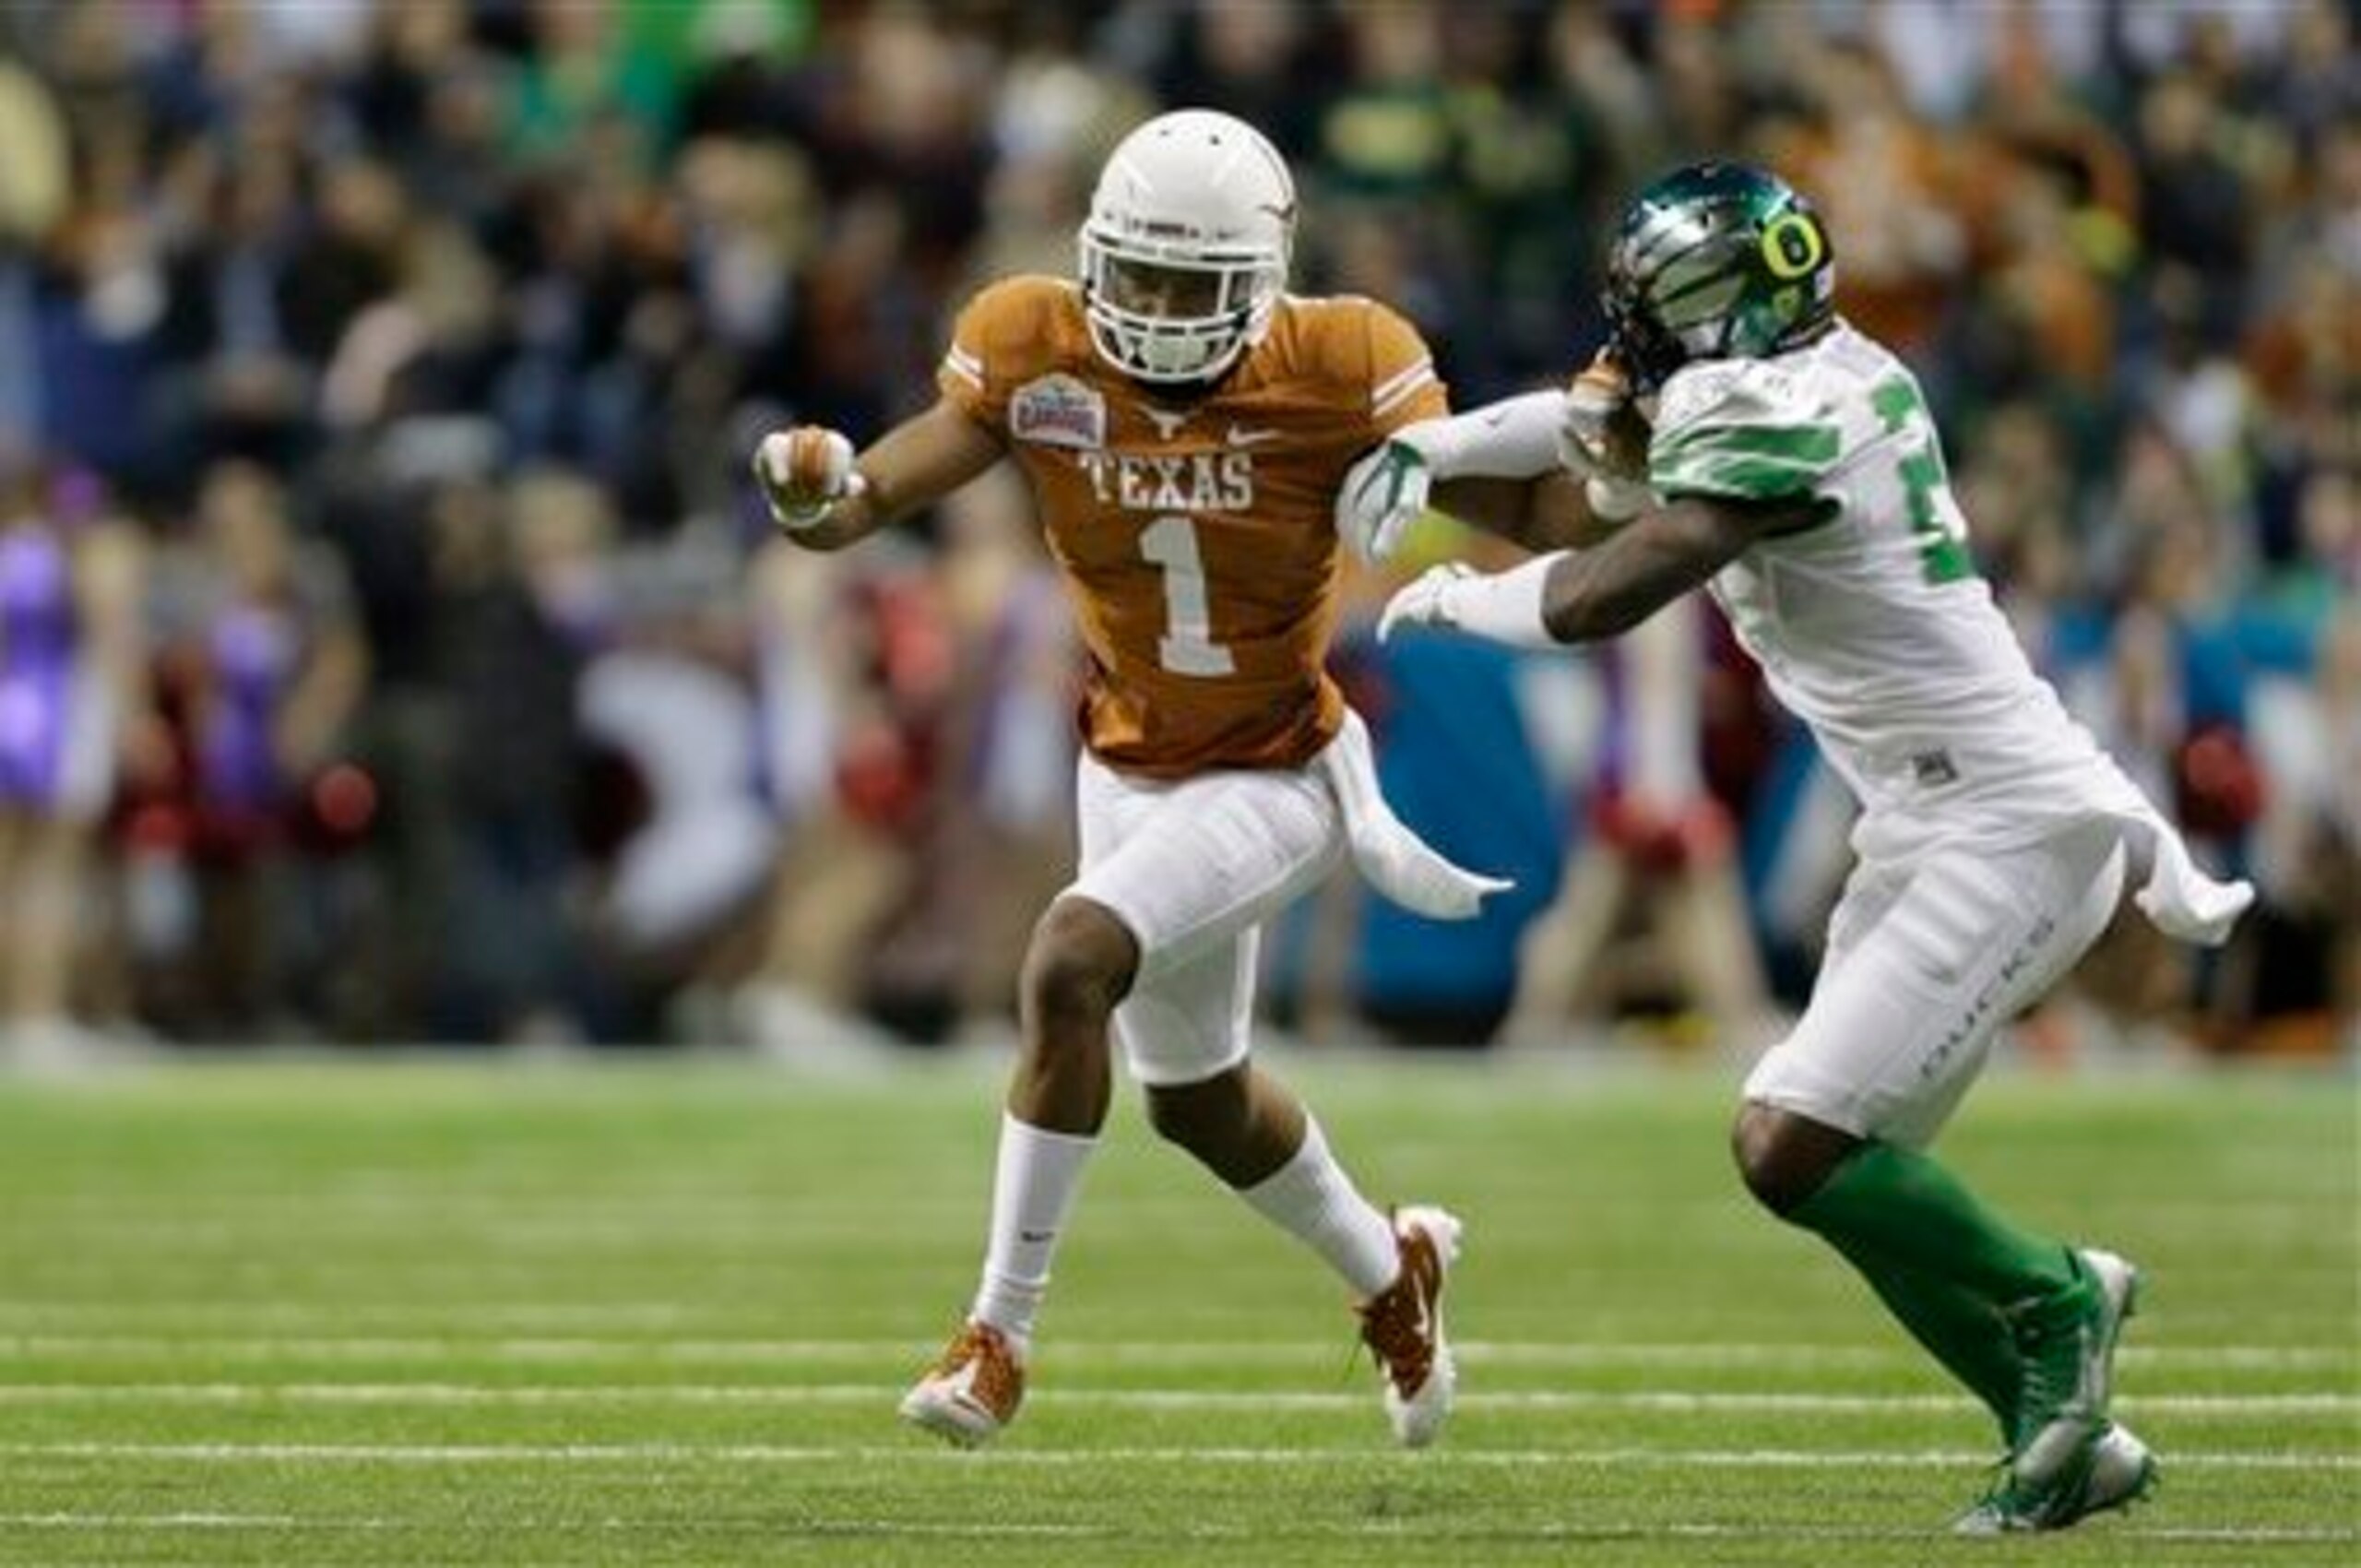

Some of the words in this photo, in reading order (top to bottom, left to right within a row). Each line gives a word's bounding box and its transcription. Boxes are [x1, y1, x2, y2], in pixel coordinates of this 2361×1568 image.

[1762, 213, 1822, 279] O
[1080, 448, 1254, 511] TEXAS
[1138, 517, 1237, 678] 1
[1920, 914, 2055, 1078] DUCKS
